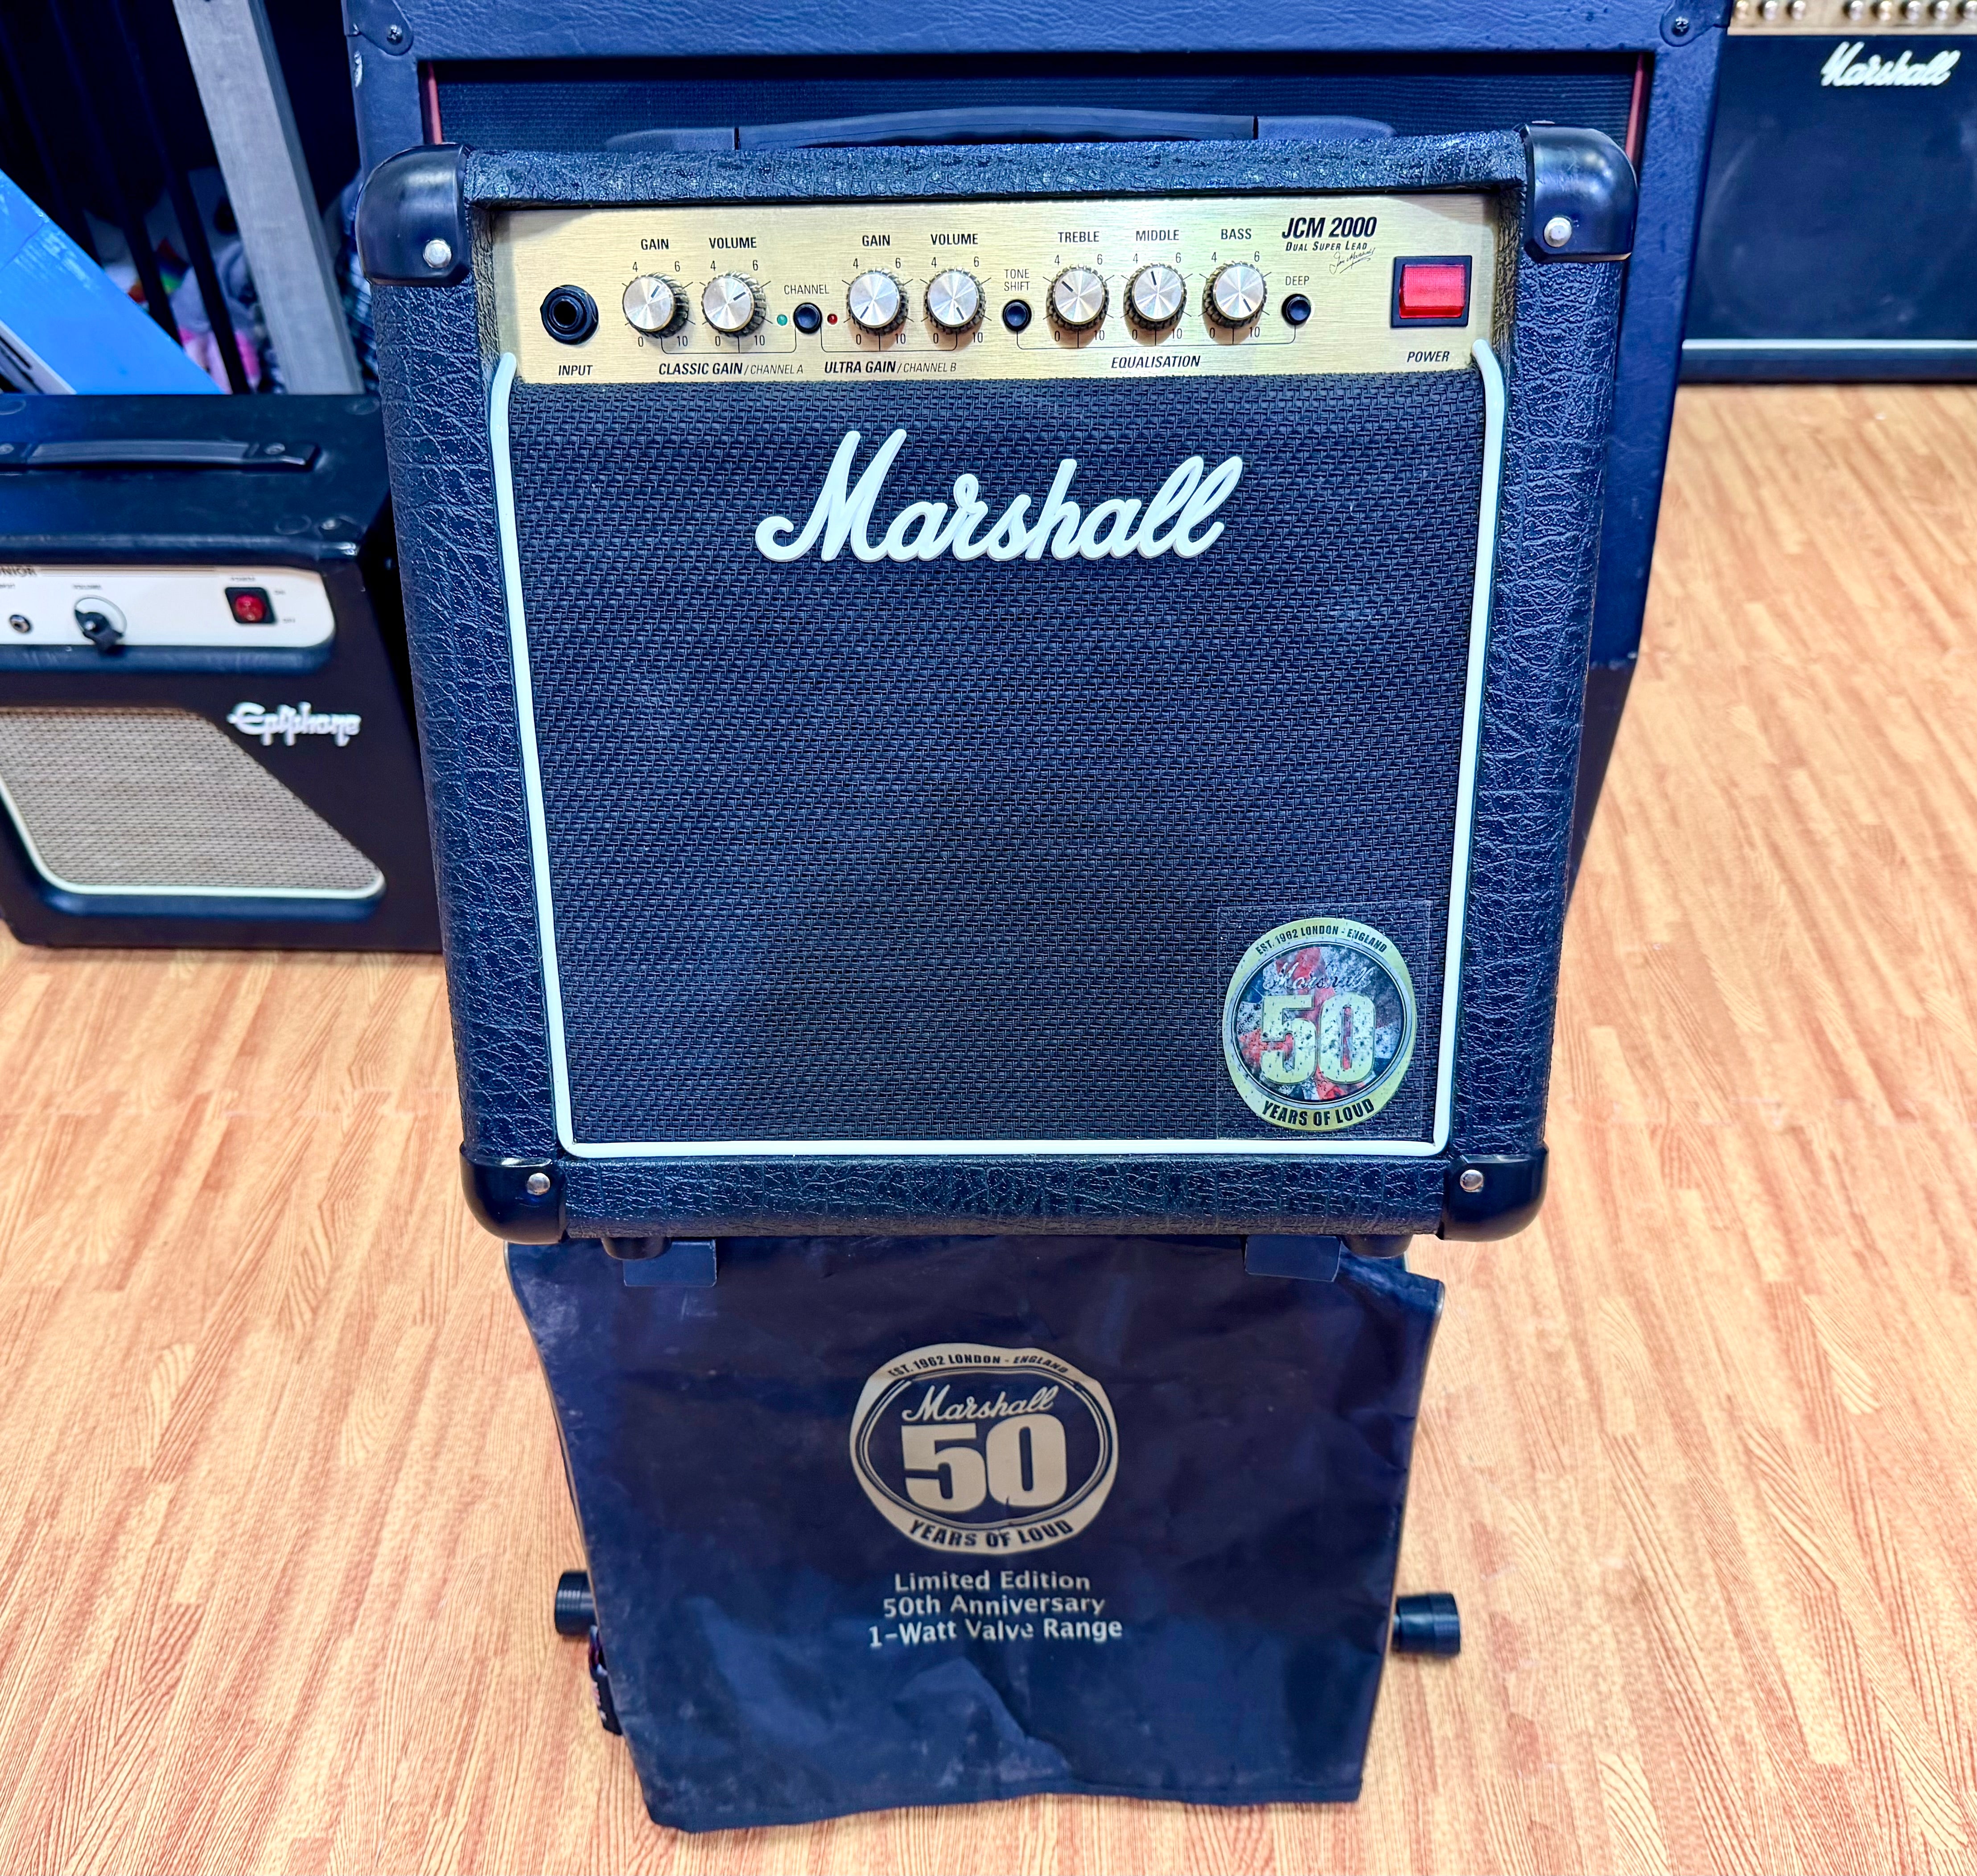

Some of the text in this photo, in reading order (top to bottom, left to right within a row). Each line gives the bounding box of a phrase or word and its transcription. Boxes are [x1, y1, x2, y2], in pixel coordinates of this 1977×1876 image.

[1820, 41, 1961, 86] Marshall
[1282, 217, 1377, 239] JCM 2000
[931, 234, 979, 245] VOLUME
[1058, 231, 1100, 243] TREBLE
[1136, 230, 1180, 241] MIDDLE
[1221, 228, 1252, 240] BASS
[640, 239, 669, 250] GAIN
[708, 237, 757, 249] VOLUME
[861, 235, 891, 247] GAIN
[973, 257, 980, 267] 6
[1054, 255, 1060, 265] 4
[1097, 254, 1103, 264] 6
[1133, 253, 1138, 264] 4
[1175, 252, 1181, 263] 6
[1211, 252, 1217, 263] 4
[1254, 251, 1260, 262] 6
[632, 261, 638, 272] 4
[674, 261, 680, 272] 6
[710, 260, 717, 271] 4
[753, 260, 758, 271] 6
[853, 258, 859, 268] 4
[895, 258, 901, 268] 6
[931, 257, 937, 268] 4
[1005, 269, 1030, 279] TONE
[1004, 281, 1030, 291] SHIFT
[1285, 276, 1309, 285] DEEP
[784, 285, 829, 295] CHANNEL
[972, 332, 983, 343] 10
[1054, 331, 1060, 342] 0
[1095, 330, 1105, 341] 10
[1132, 329, 1137, 340] 0
[1172, 328, 1182, 339] 10
[1210, 328, 1215, 338] 0
[1250, 326, 1260, 338] 10
[638, 336, 643, 347] 0
[677, 335, 688, 347] 10
[715, 335, 721, 346] 0
[754, 335, 765, 346] 10
[856, 334, 861, 345] 0
[895, 334, 906, 344] 10
[933, 333, 939, 343] 0
[1112, 356, 1201, 369] EQUALISATION
[1406, 351, 1450, 363] POWER
[558, 365, 593, 376] INPUT
[659, 363, 710, 375] CLASSIC
[796, 364, 803, 374] A
[824, 361, 862, 374] ULTRA
[950, 362, 957, 372] B
[755, 429, 1243, 562] Marshall
[227, 701, 362, 746] Epiphone
[1255, 940, 1274, 955] EST.
[1275, 929, 1299, 944] 1962
[1301, 925, 1339, 936] LONDON
[1347, 929, 1388, 953] ENGLAND
[1263, 962, 1372, 990] Marshall
[1260, 992, 1376, 1084] 50
[1262, 1099, 1375, 1126] YEARS OF LOUD
[888, 1364, 914, 1377] EST.
[915, 1355, 946, 1369] 1962
[949, 1354, 1001, 1364] LONDON
[1013, 1356, 1069, 1374] ENGLAND
[902, 1385, 1058, 1421] Marshall
[901, 1413, 1067, 1512] 50
[909, 1519, 1073, 1547] YEARS OF LOUD
[894, 1570, 1090, 1592] Limited Edition
[883, 1594, 1105, 1618] 50th Anniversary
[869, 1618, 1123, 1649] 1-Watt Valve Range
